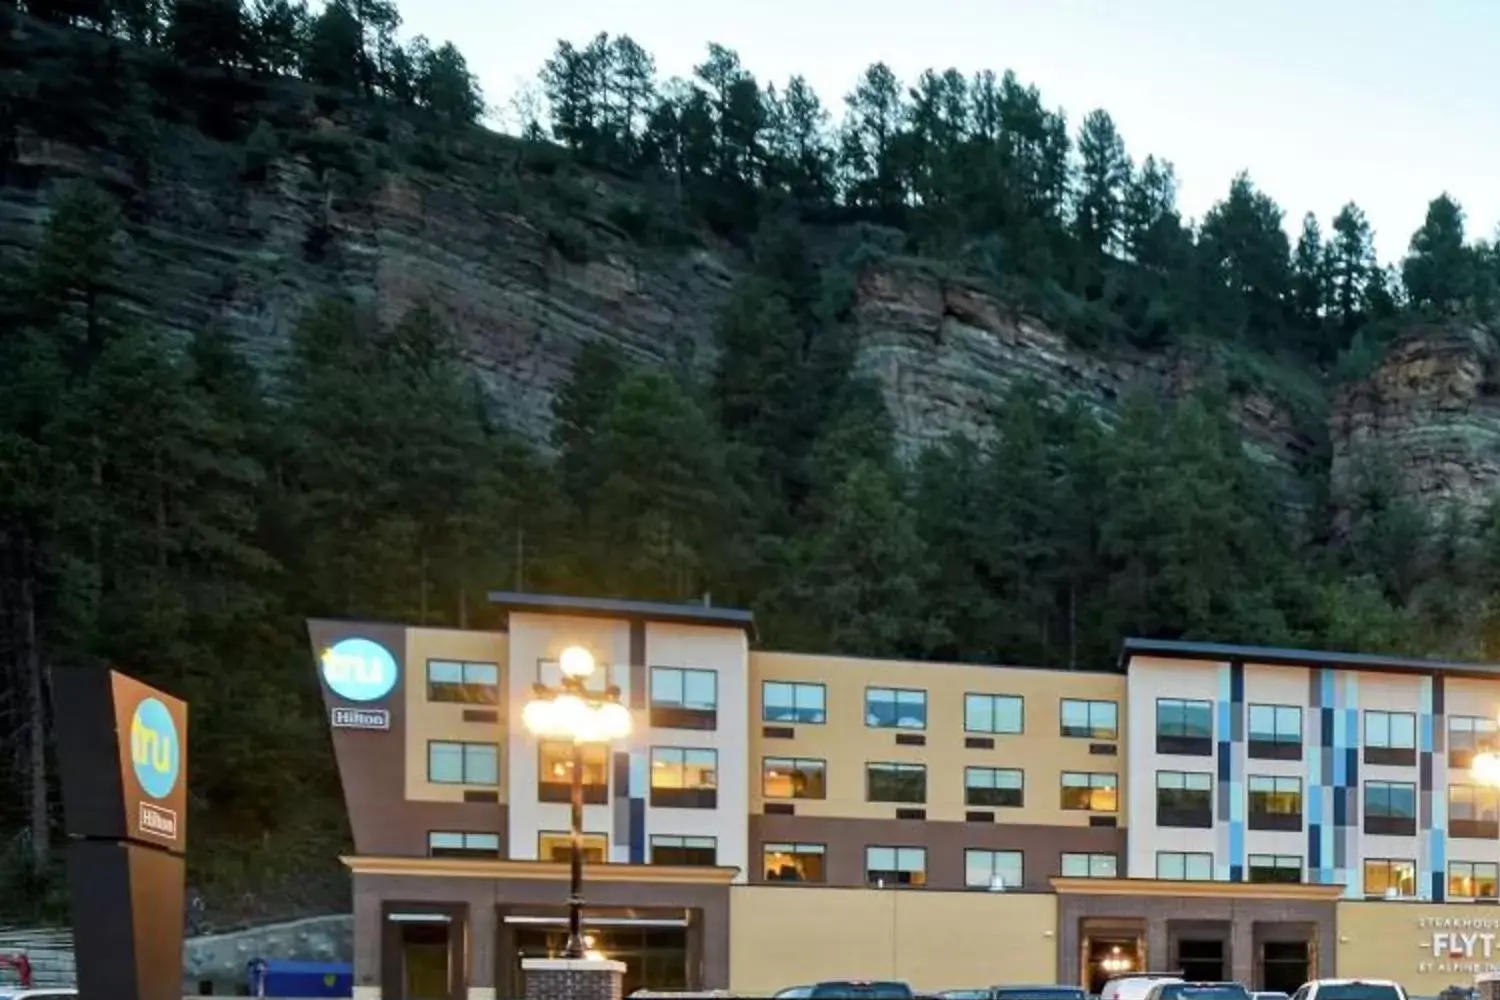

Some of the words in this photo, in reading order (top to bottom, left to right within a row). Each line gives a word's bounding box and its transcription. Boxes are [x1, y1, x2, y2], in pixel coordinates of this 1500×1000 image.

[321, 647, 383, 683] tru
[336, 710, 384, 725] Hilton
[131, 713, 171, 774] tru
[143, 808, 174, 832] Hilton
[1433, 932, 1496, 958] FLYT
